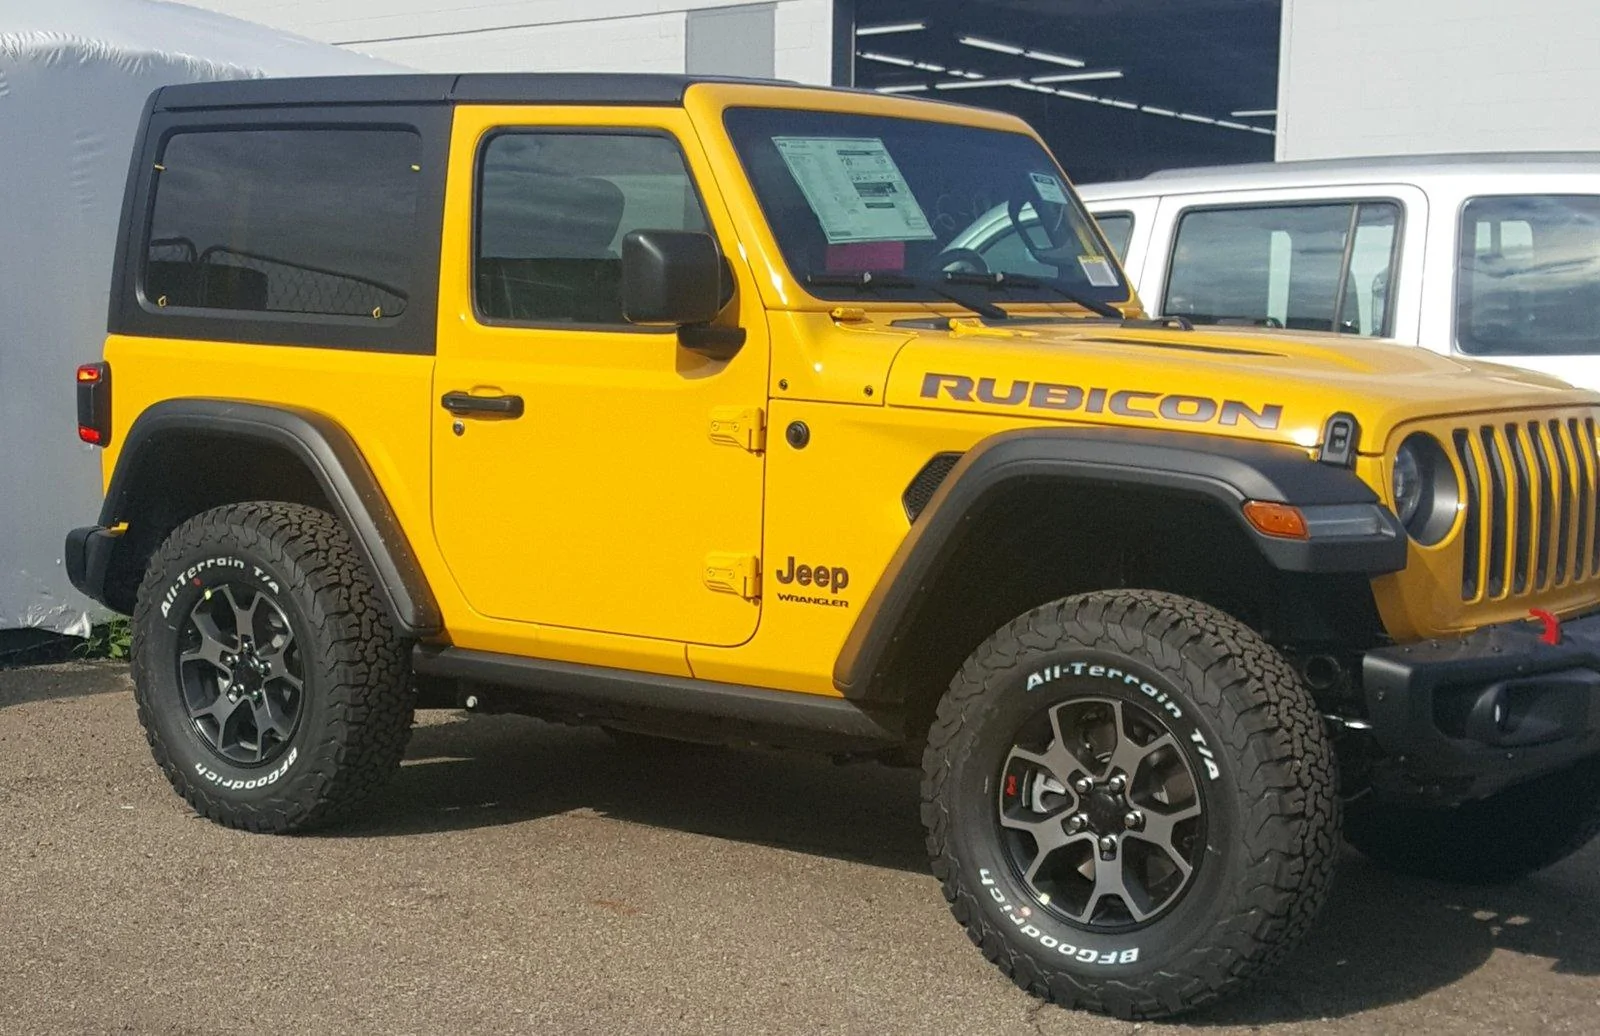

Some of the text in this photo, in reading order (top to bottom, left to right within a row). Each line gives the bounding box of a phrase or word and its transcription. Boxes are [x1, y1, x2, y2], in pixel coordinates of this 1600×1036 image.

[920, 372, 1283, 430] RUBICON
[160, 556, 279, 619] All-Terrain T/A
[776, 556, 849, 594] Jeep
[777, 592, 849, 608] WRANGLER
[1026, 662, 1220, 781] All-Terrain T/A
[195, 747, 298, 790] BFGoodrich
[979, 868, 1139, 965] BFGoodrich
